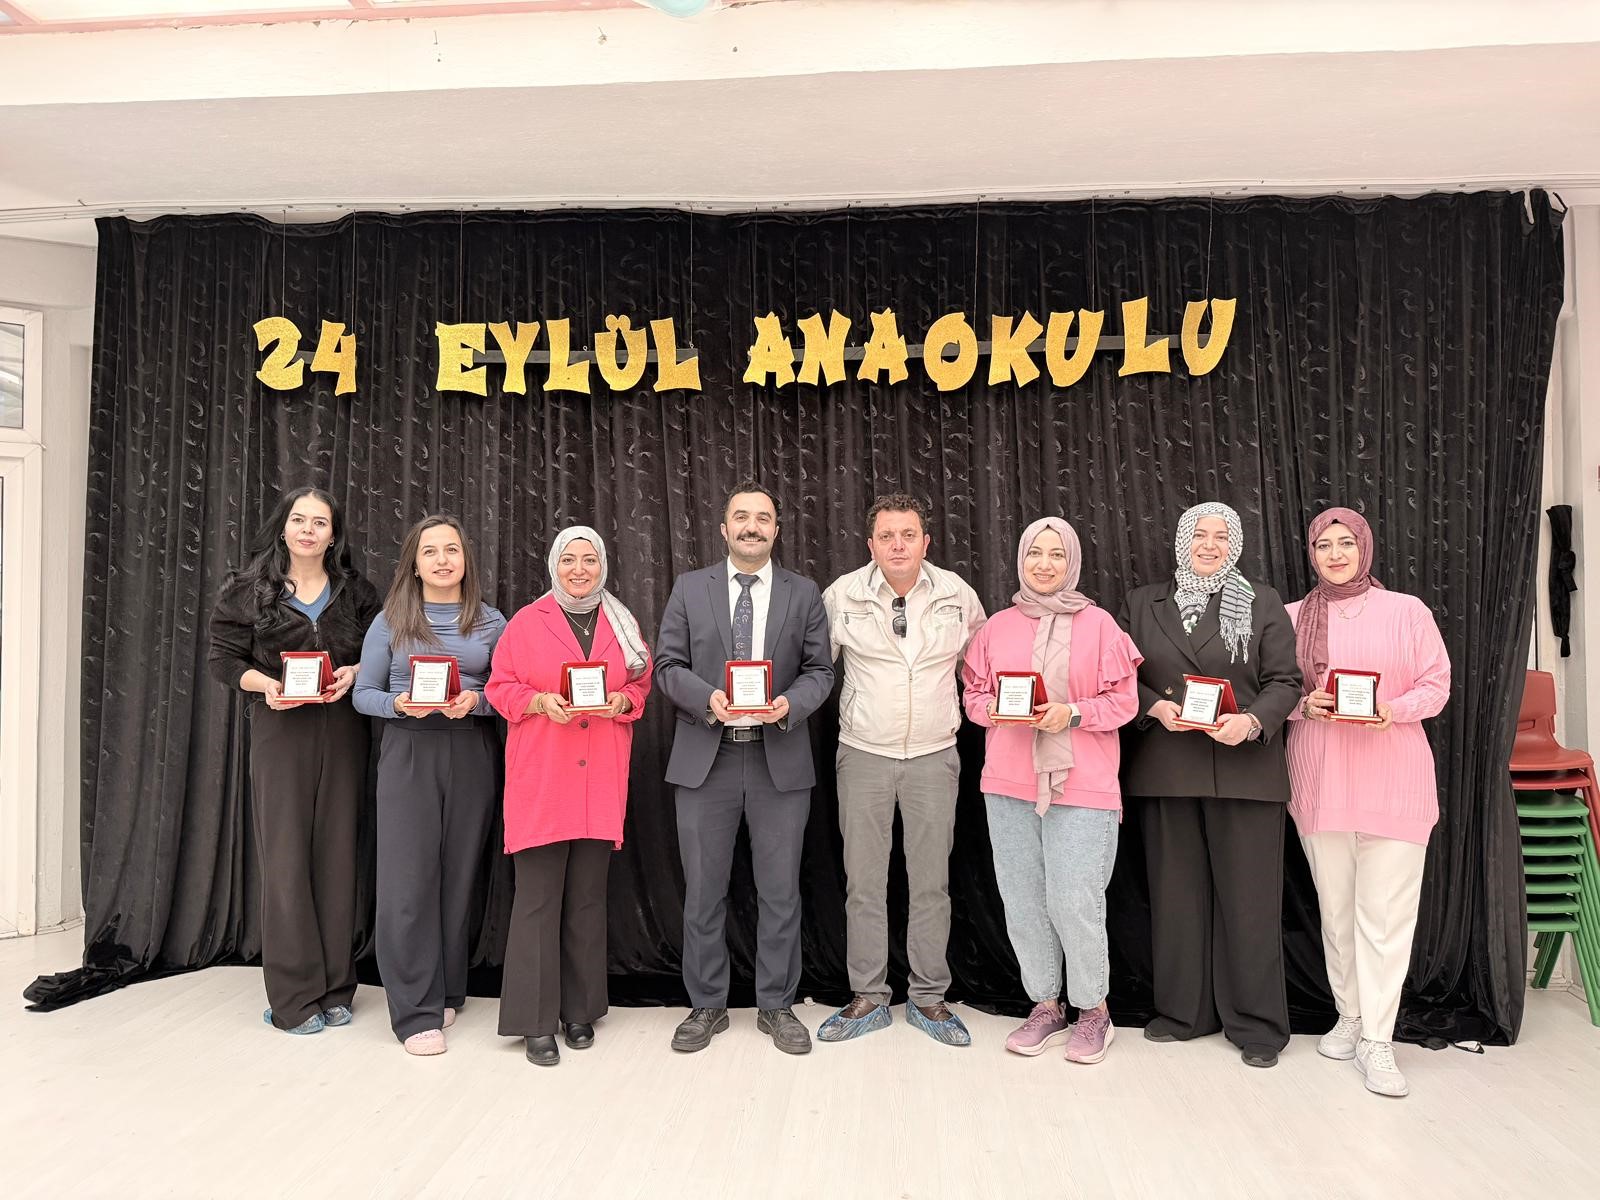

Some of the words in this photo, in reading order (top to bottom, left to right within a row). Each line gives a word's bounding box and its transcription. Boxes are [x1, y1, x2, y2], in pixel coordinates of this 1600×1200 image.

[254, 317, 356, 396] 24
[435, 315, 701, 396] EYLÜL
[743, 297, 1236, 391] ANAOKULU
